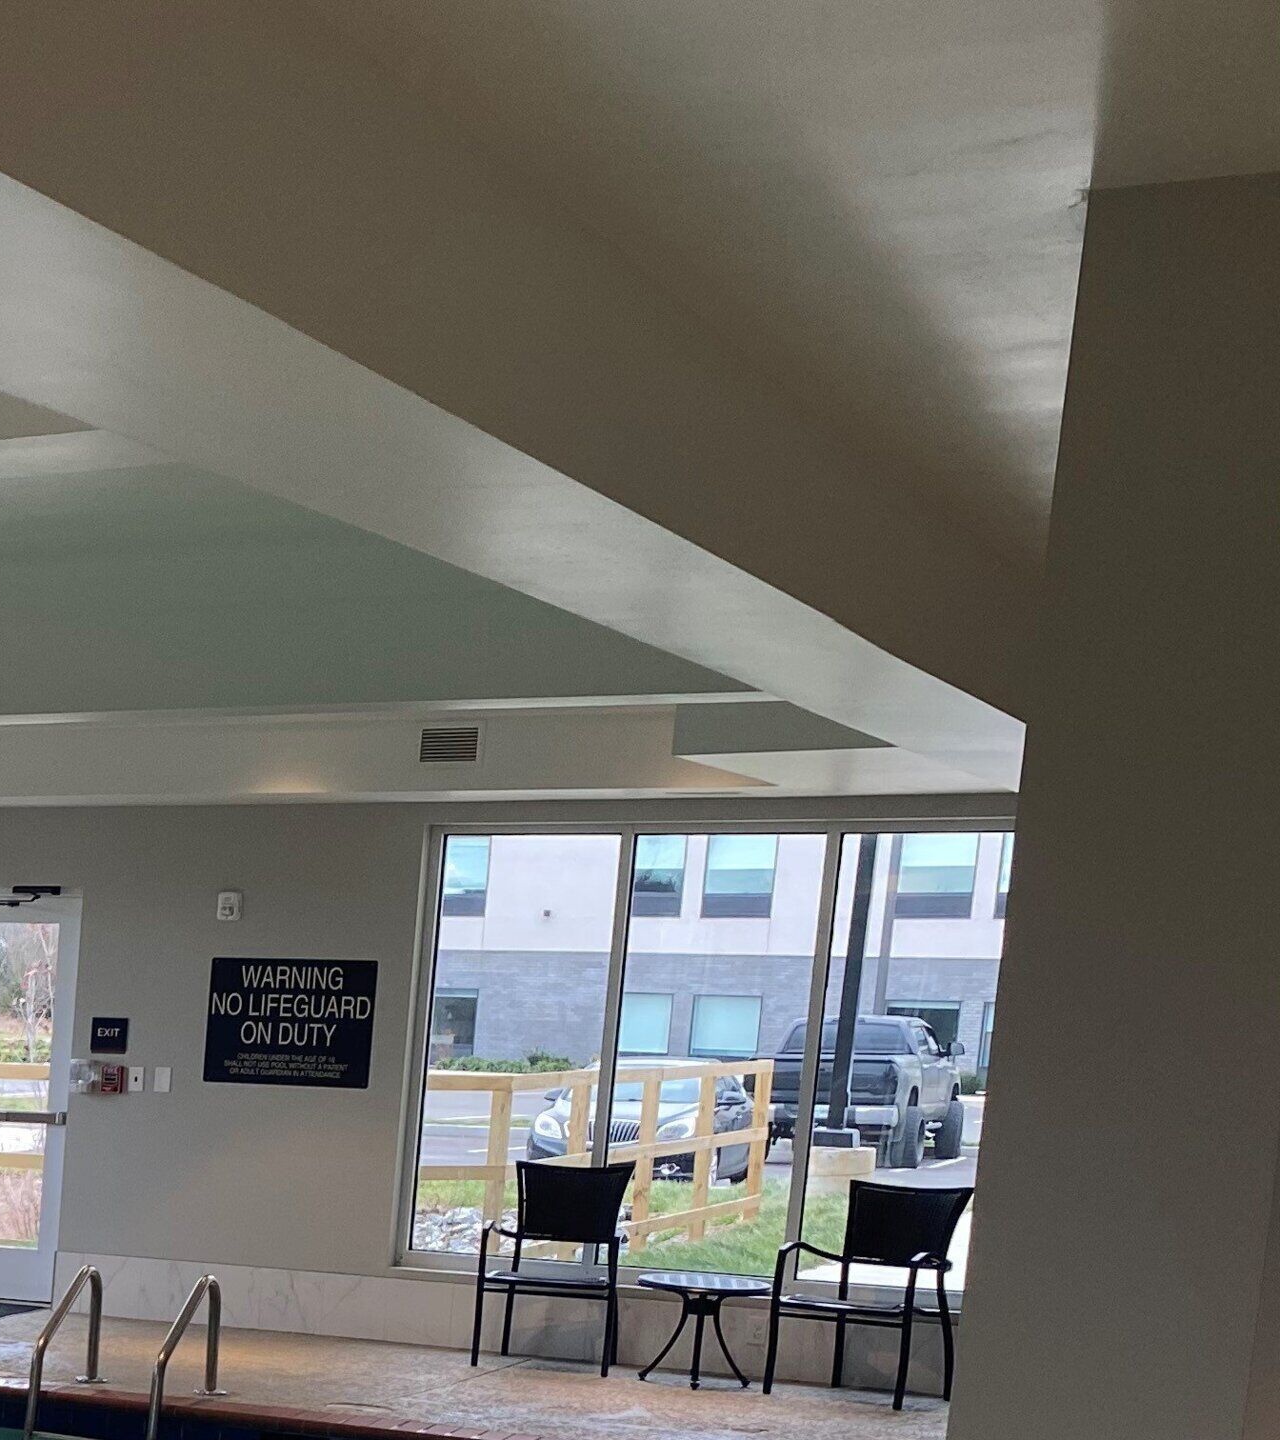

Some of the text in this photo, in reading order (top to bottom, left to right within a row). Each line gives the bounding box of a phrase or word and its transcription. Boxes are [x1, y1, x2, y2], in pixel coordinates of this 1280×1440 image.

[242, 965, 344, 990] WARNING
[211, 992, 371, 1019] NO LIFEGUARD
[97, 1028, 120, 1037] EXIT
[240, 1021, 337, 1047] ON DUTY
